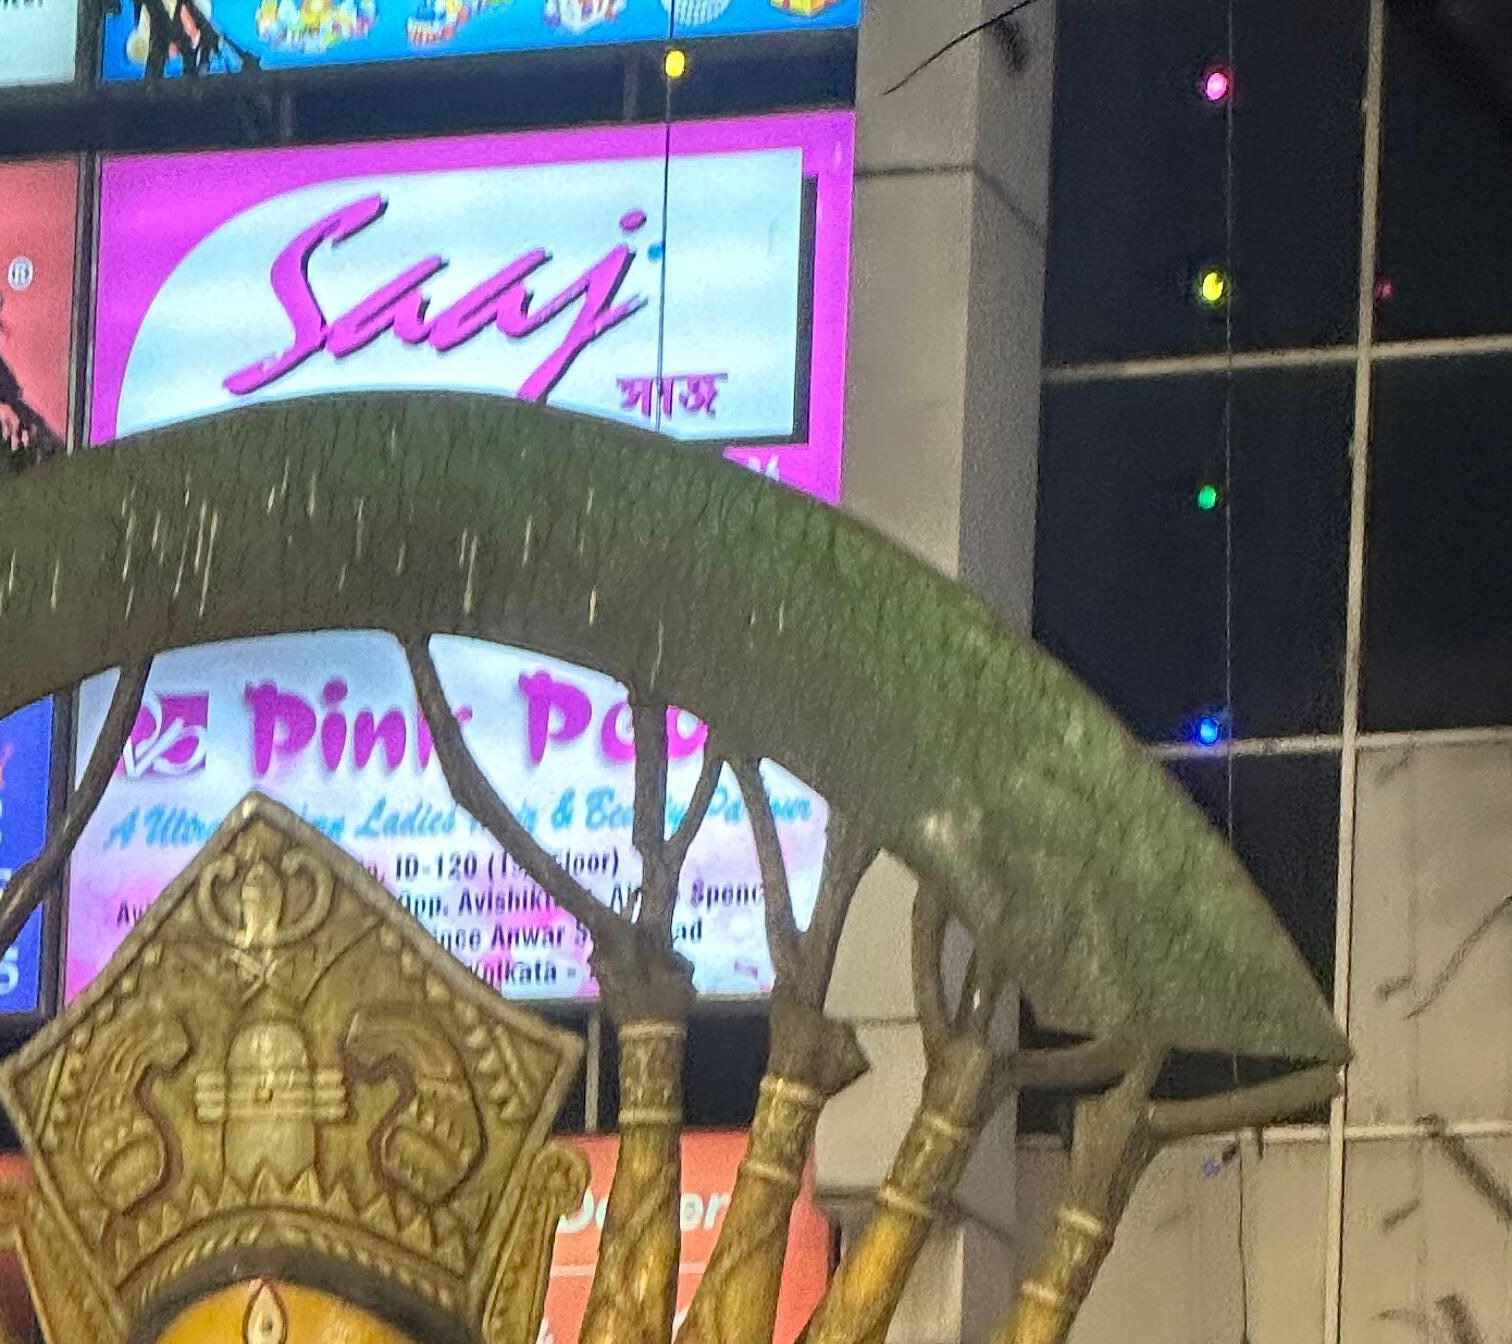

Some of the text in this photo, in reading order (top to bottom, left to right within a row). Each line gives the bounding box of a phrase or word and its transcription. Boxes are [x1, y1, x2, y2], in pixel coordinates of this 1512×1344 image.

[222, 190, 650, 400] Saaj
[617, 372, 728, 421] সাজ
[556, 846, 619, 878] loor)
[490, 922, 565, 950] Anwar
